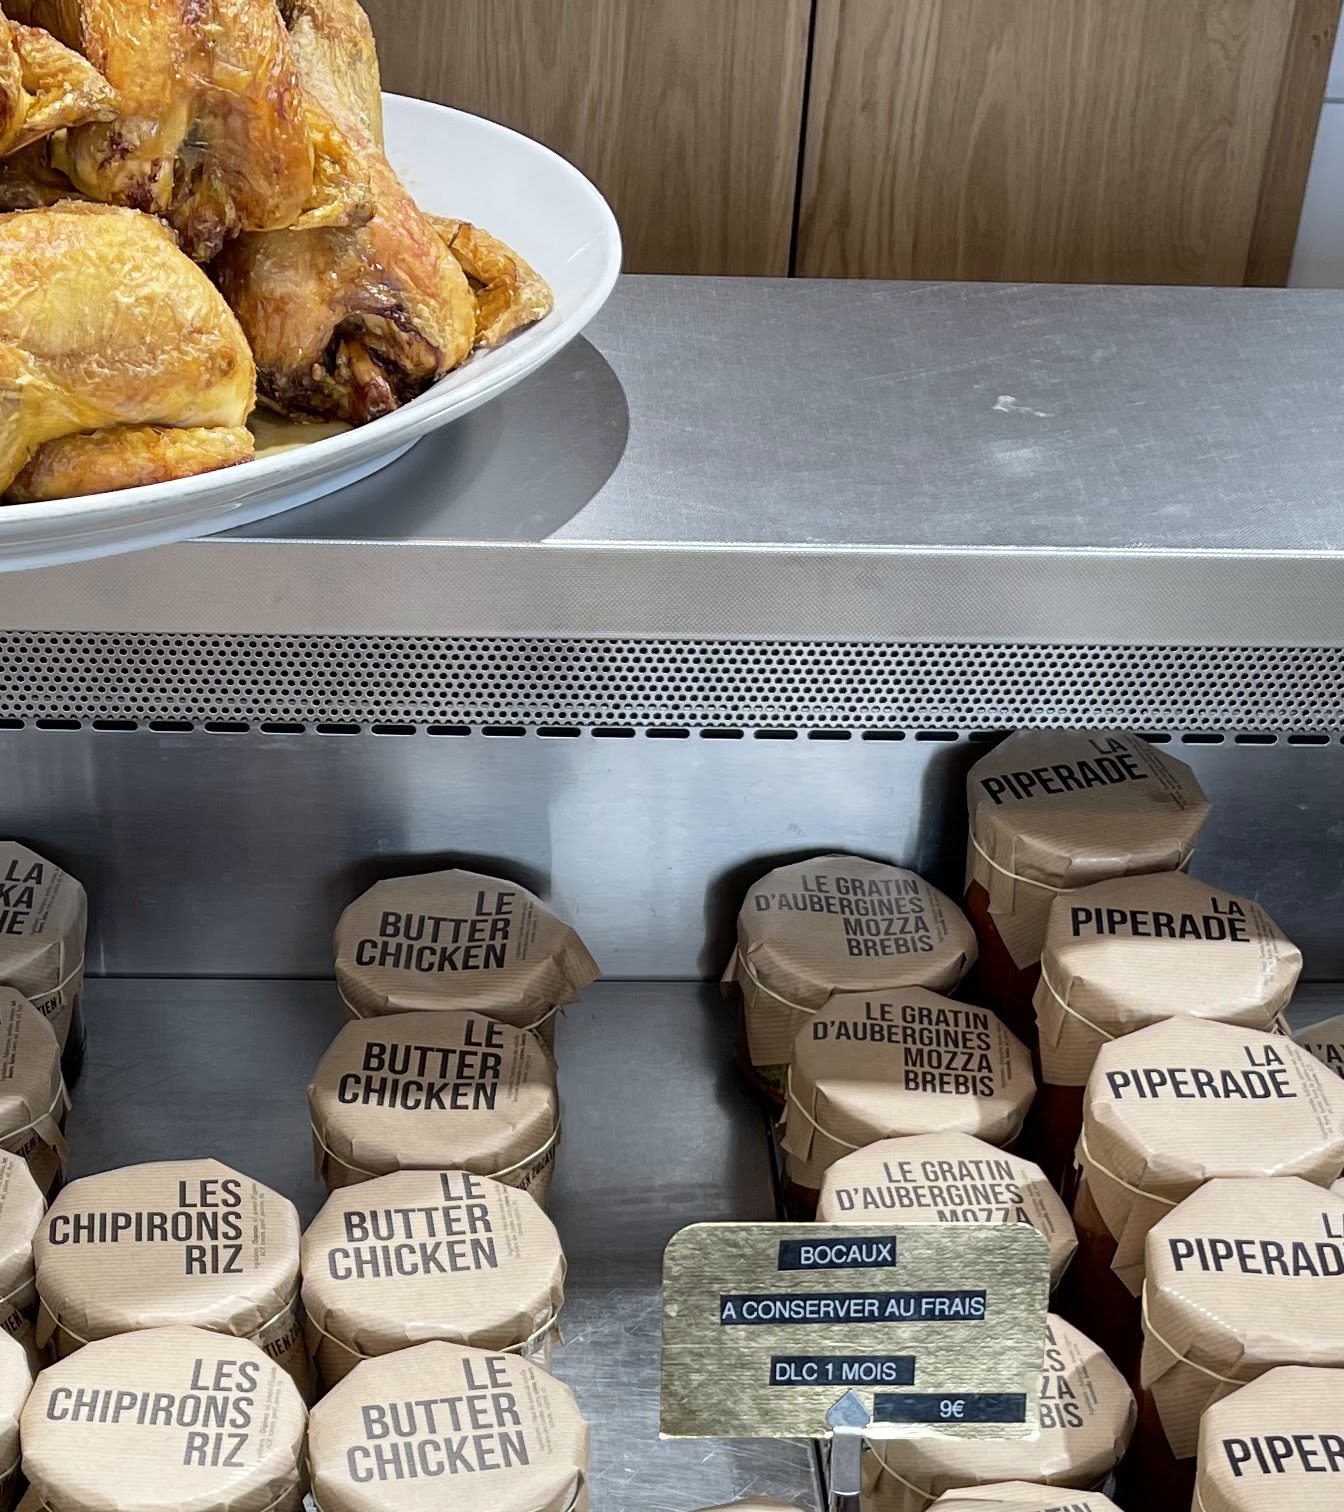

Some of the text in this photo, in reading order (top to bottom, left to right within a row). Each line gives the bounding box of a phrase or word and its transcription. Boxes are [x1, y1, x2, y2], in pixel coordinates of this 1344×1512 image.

[1089, 737, 1128, 754] LA
[980, 753, 1147, 804] PIPERADE
[5, 860, 43, 885] LA
[802, 876, 919, 896] LE GRATIN
[475, 891, 515, 916] LE
[1210, 897, 1245, 916] LA
[379, 912, 511, 943] BUTTER
[843, 916, 930, 937] MOZZA
[1071, 906, 1250, 942] PIPERADE
[356, 939, 506, 972] CHICKEN
[846, 935, 933, 957] BREBIS
[179, 1180, 242, 1208] LES
[440, 1173, 486, 1201] LE
[49, 1211, 242, 1245] CHIPIRONS
[344, 1204, 492, 1242] BUTTER
[186, 1244, 243, 1274] RIZ
[328, 1237, 498, 1280] CHICKEN
[801, 1244, 892, 1264] BOCAUX
[722, 1297, 984, 1319] A CONSERVER AU FRAIS
[776, 1363, 897, 1380] DLC 1 MOIS
[940, 1400, 964, 1417] 9€
